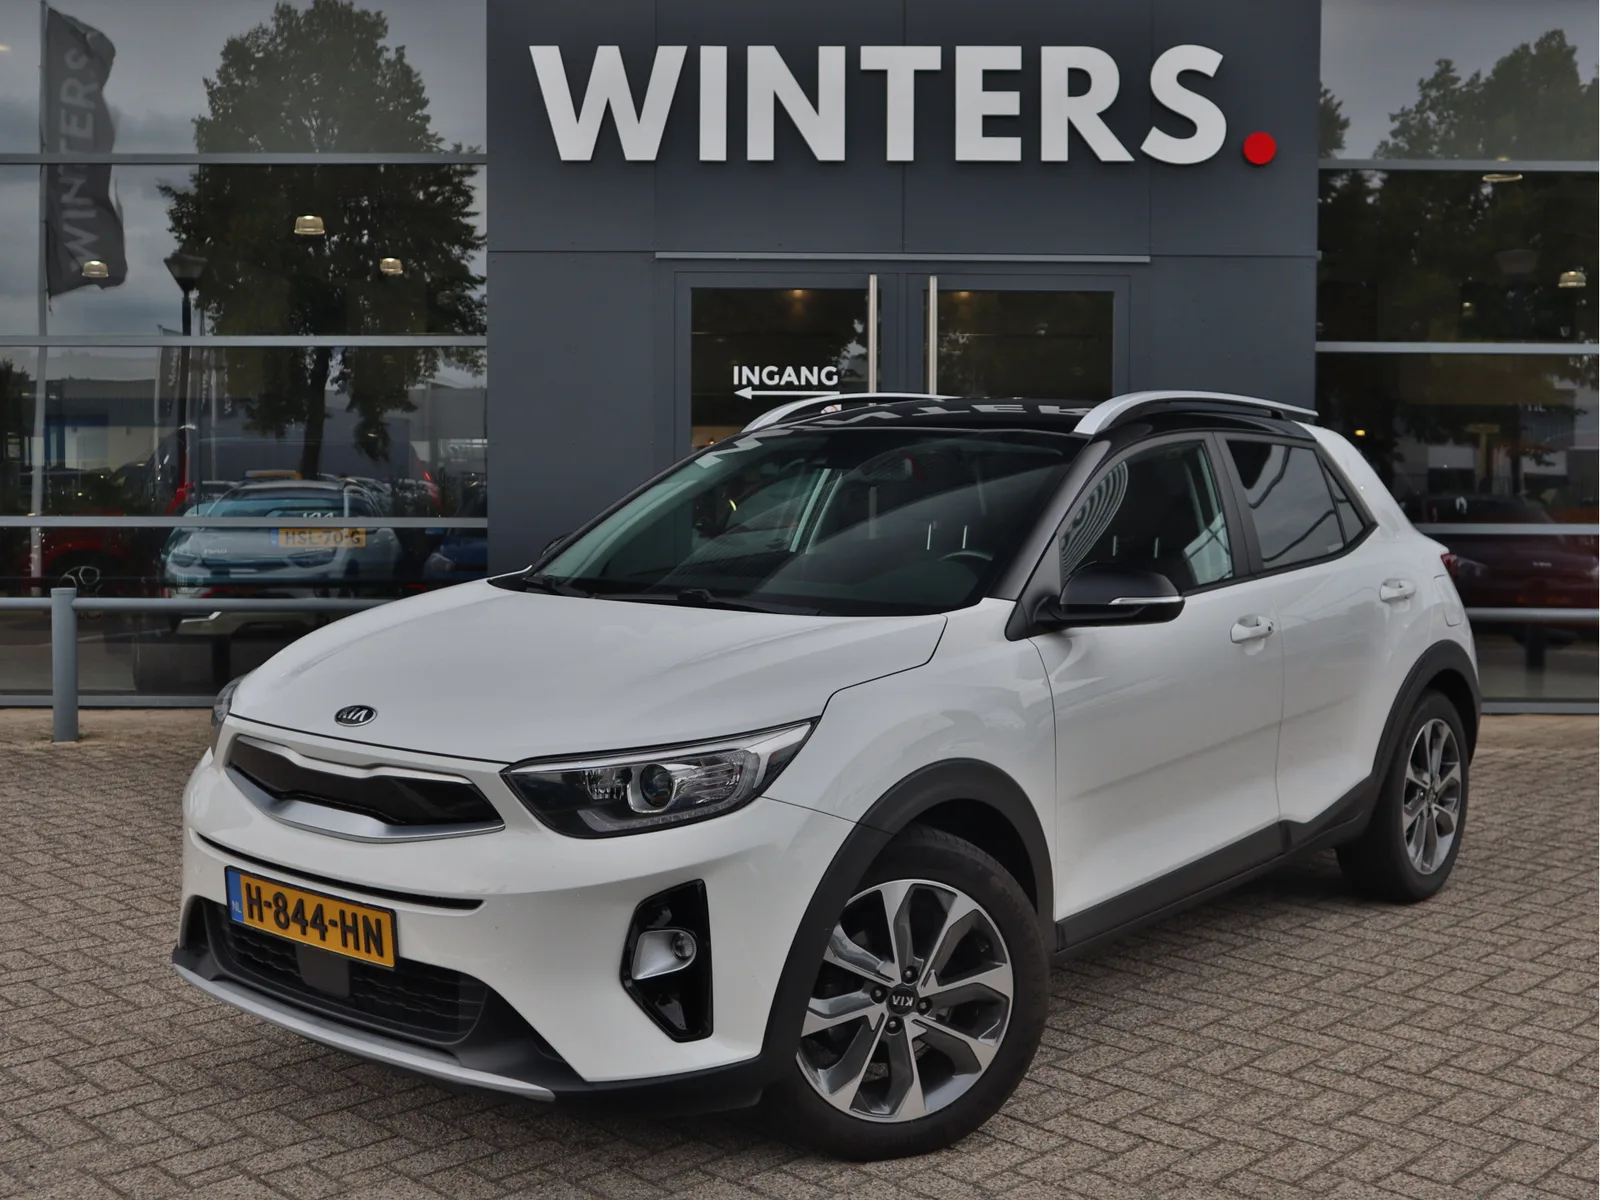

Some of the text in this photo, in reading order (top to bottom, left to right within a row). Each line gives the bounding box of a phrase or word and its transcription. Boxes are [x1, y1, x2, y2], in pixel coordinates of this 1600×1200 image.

[733, 365, 839, 386] INGANG
[337, 706, 369, 722] KIA
[231, 900, 242, 914] NL
[245, 882, 384, 957] H-844-HN
[892, 995, 914, 1006] KIA
